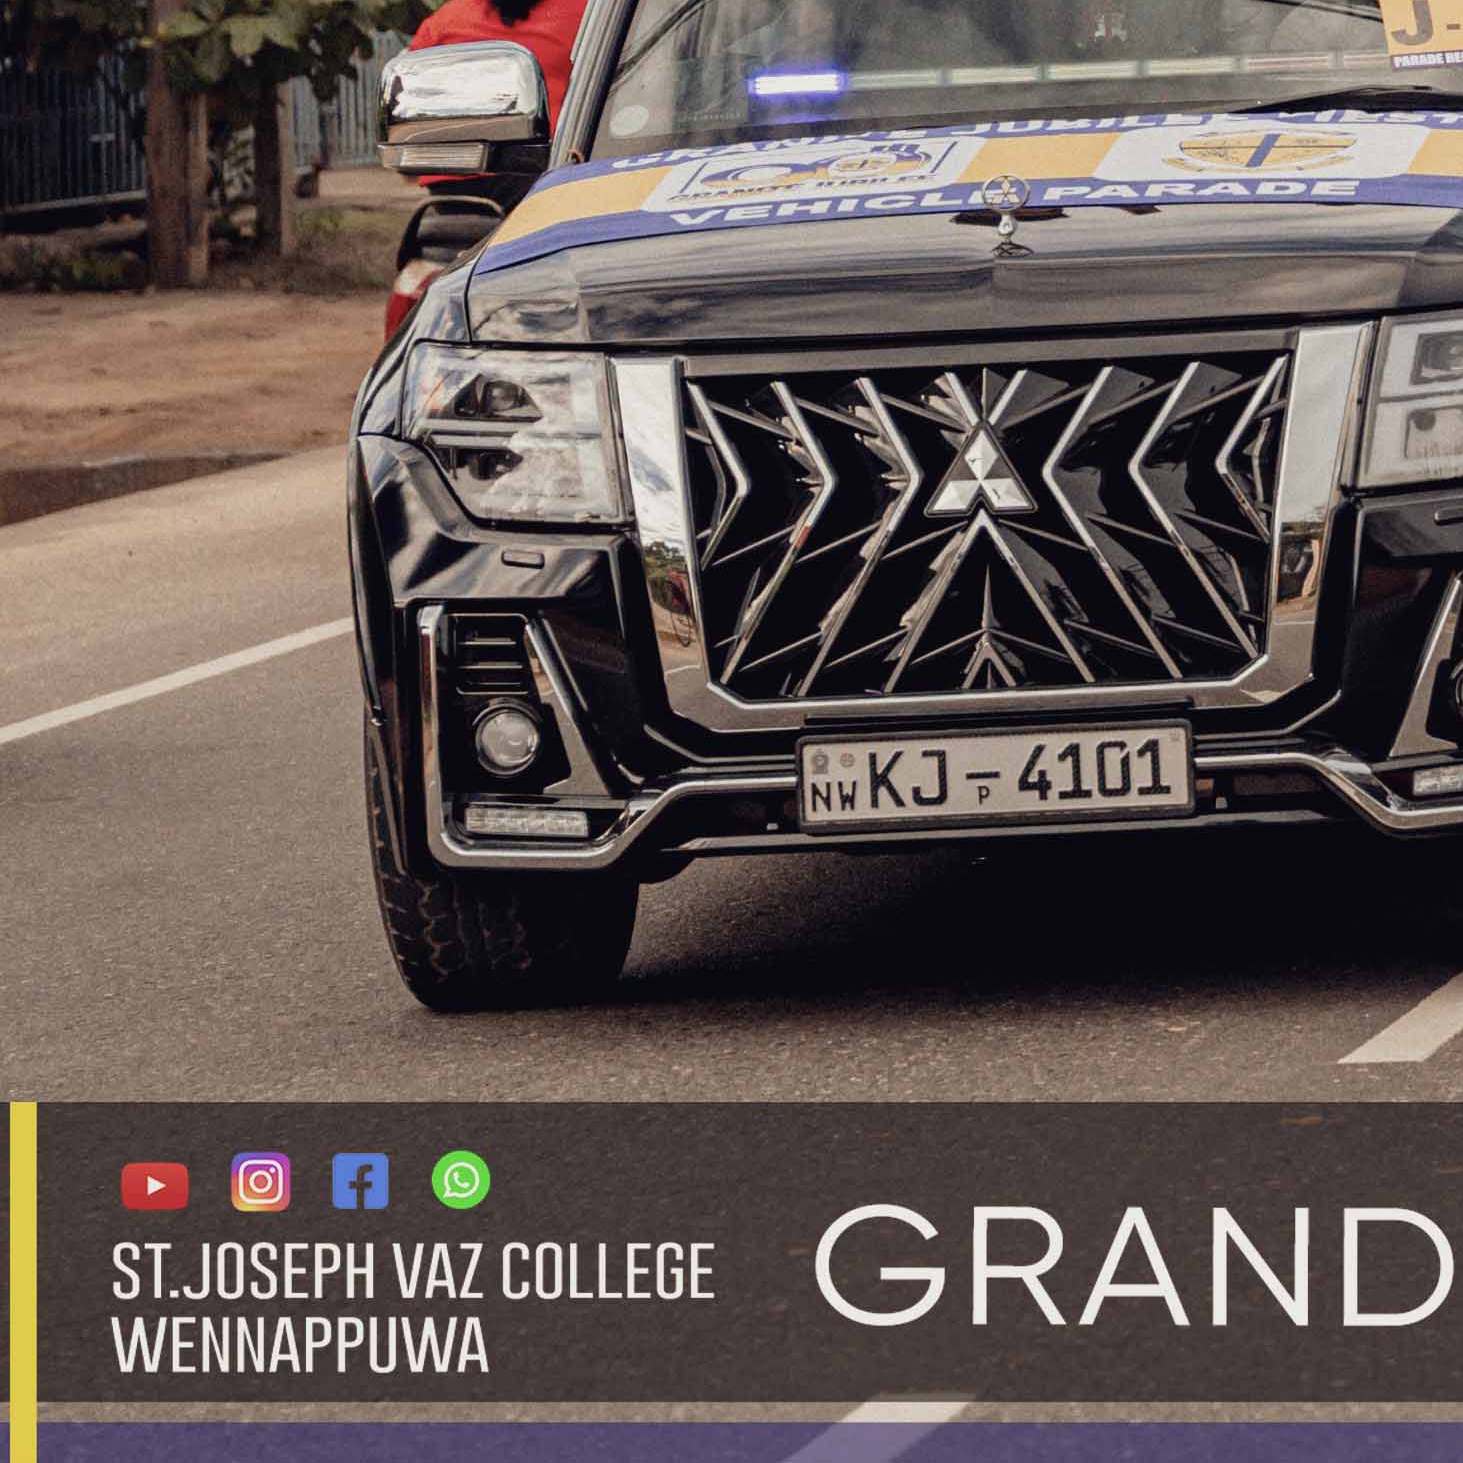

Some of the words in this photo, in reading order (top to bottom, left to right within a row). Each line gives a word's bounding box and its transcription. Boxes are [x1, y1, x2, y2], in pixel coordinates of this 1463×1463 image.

[1393, 53, 1445, 68] PARADE
[1042, 179, 1361, 202] PARADE
[811, 780, 857, 813] NW
